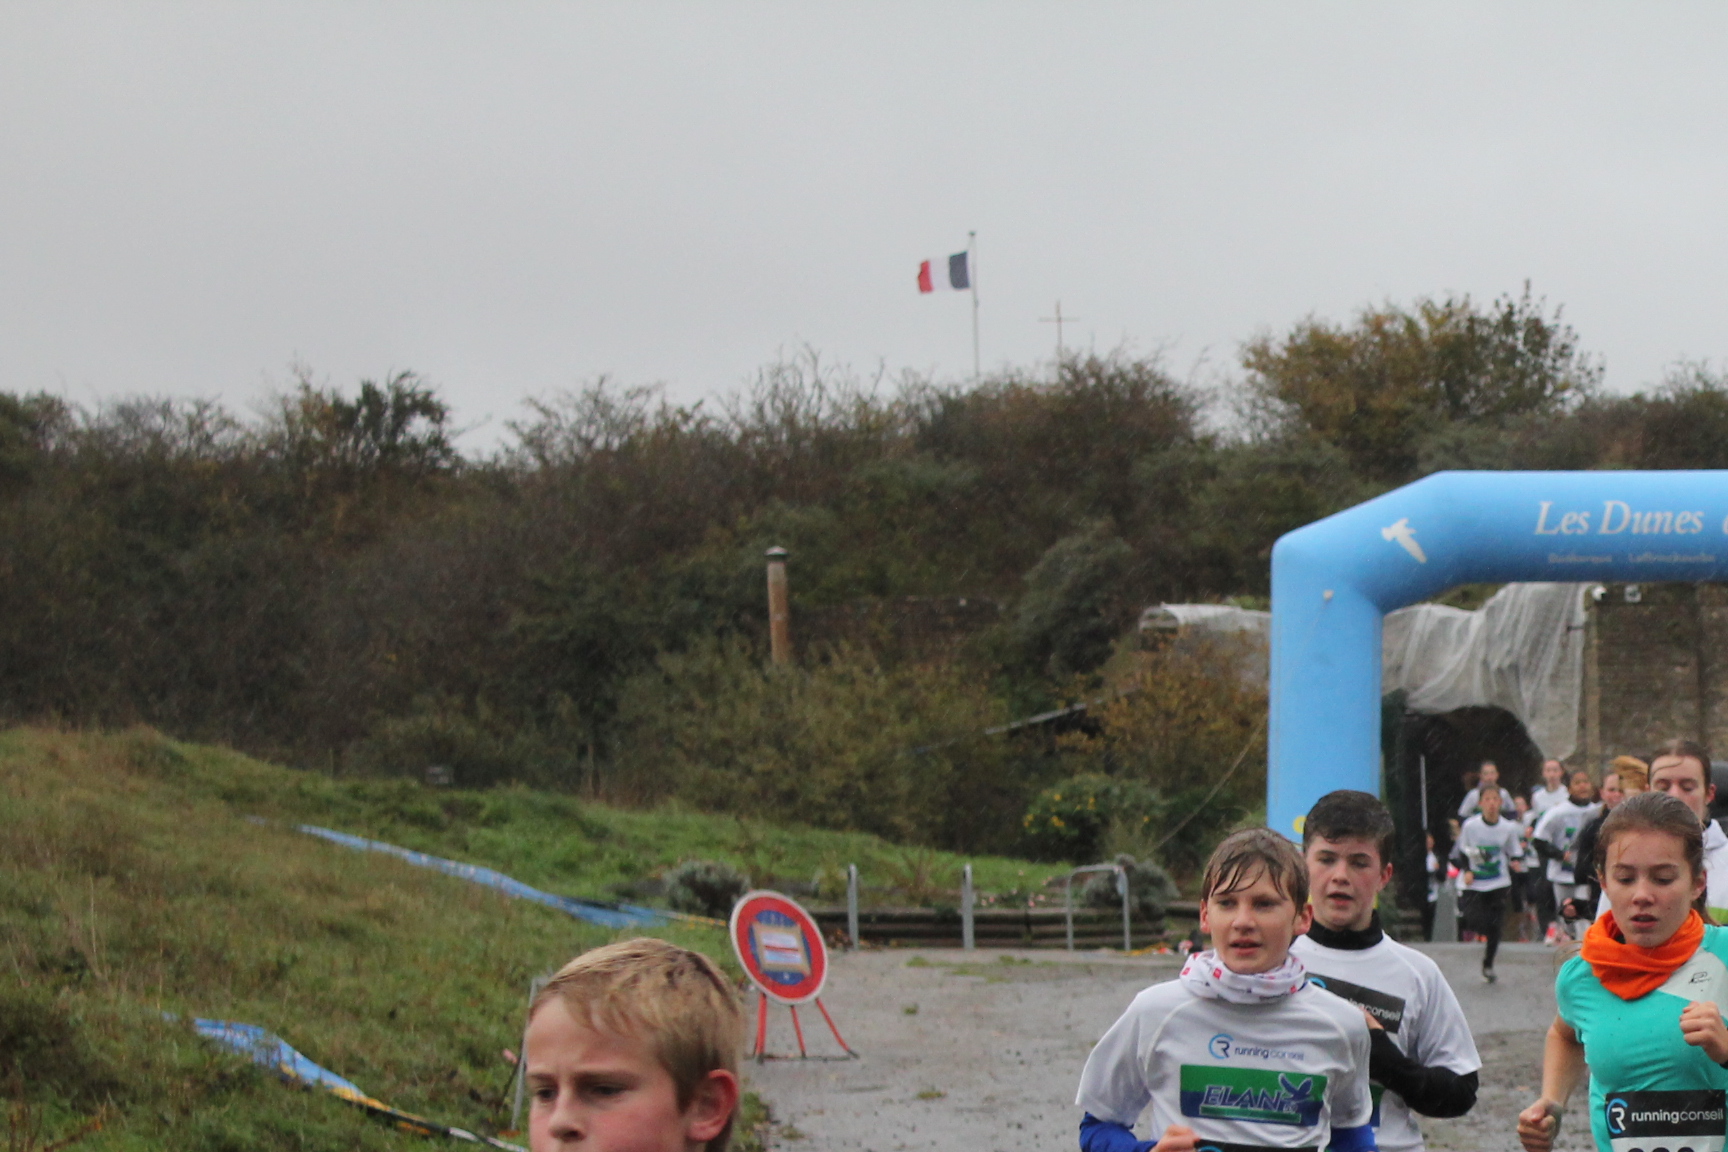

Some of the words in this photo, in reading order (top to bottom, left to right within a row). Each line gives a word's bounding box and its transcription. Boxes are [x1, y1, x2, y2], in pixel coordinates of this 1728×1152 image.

[1534, 499, 1590, 536] Les
[1597, 499, 1704, 536] Dunes
[1201, 1084, 1282, 1112] ELAN
